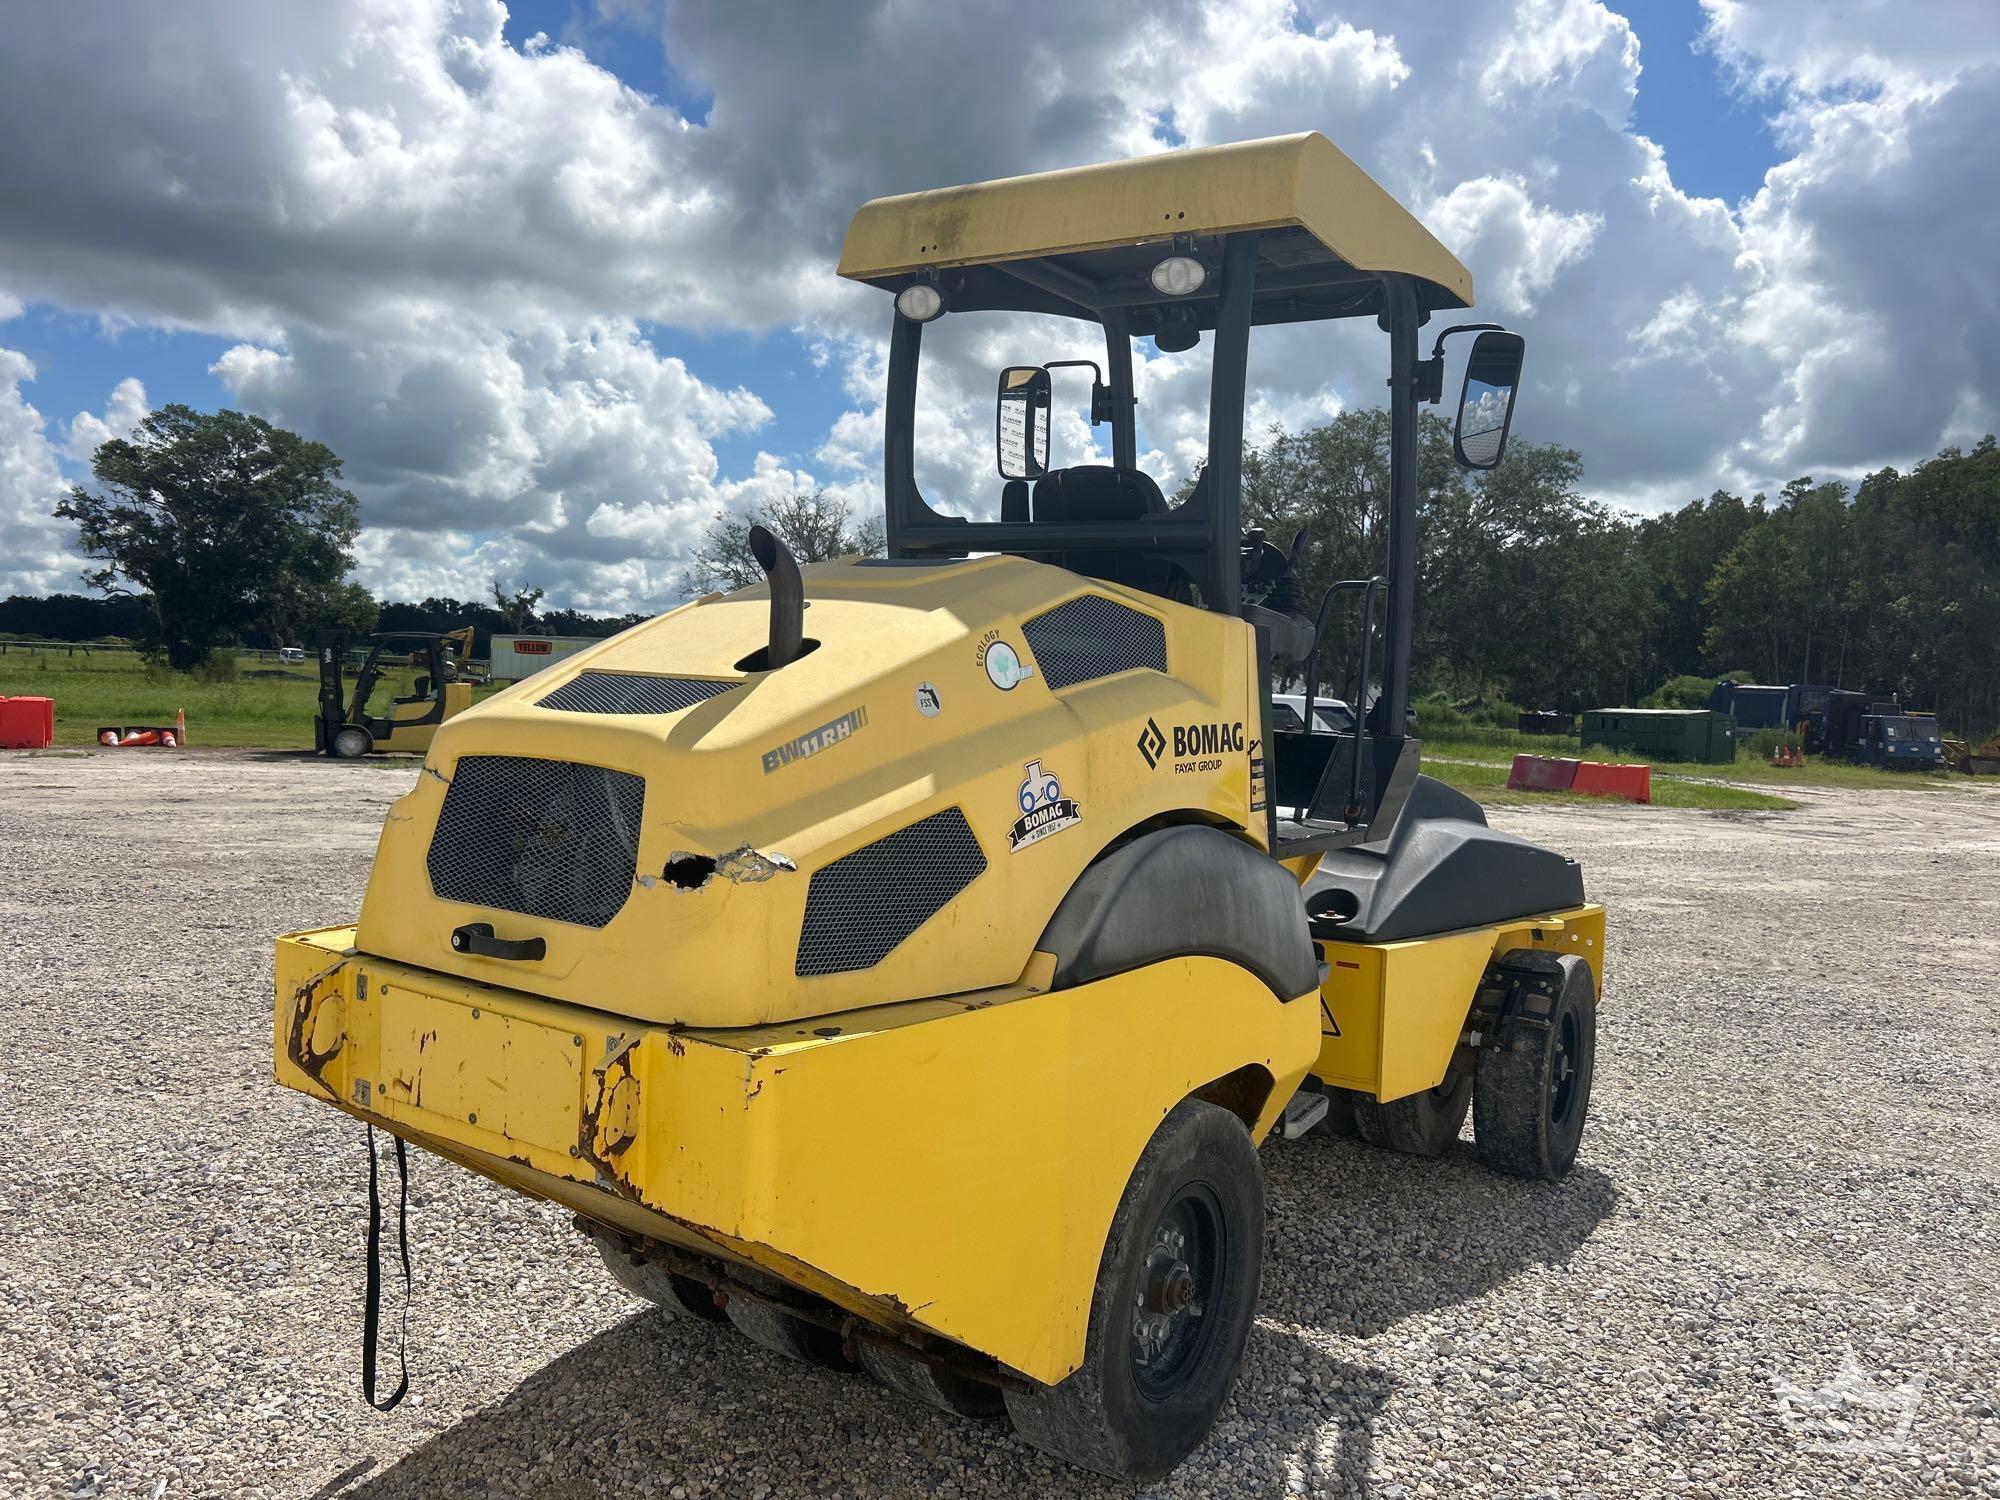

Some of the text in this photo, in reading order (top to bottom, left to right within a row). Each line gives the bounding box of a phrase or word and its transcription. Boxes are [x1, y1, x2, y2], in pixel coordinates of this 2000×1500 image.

[518, 643, 548, 653] YELLOW
[976, 629, 1000, 667] ECOLOGY
[920, 698, 932, 708] FSS
[1173, 722, 1244, 757] BOMAG
[1175, 759, 1222, 775] FAYAT GROUP
[1024, 803, 1063, 831] BOMAG
